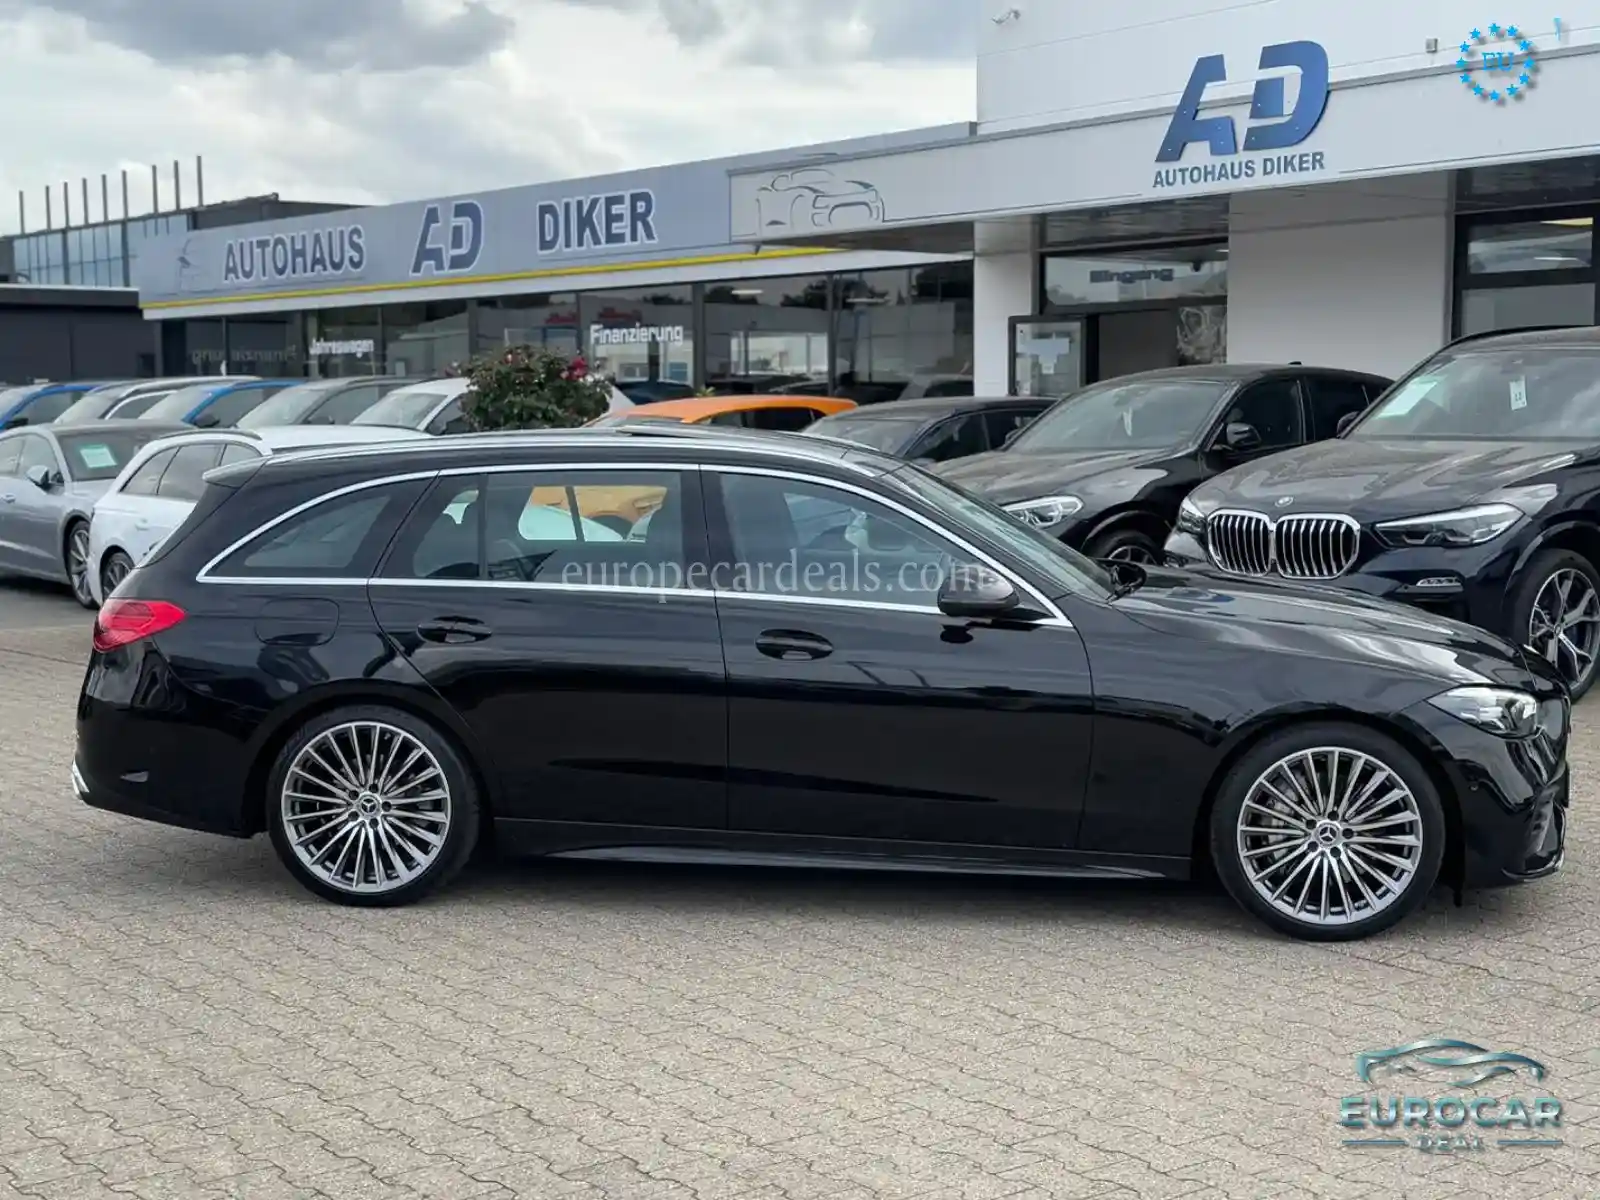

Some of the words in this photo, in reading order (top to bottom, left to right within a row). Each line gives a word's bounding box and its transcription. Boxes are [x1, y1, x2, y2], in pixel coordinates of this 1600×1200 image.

[1155, 40, 1329, 162] AD
[1153, 159, 1255, 189] AUTOHAUS
[1262, 151, 1325, 176] DIKER
[224, 226, 364, 281] AUTOHAUS
[411, 201, 483, 275] AD
[538, 191, 657, 252] DIKER
[1090, 269, 1174, 284] Eingang
[590, 323, 684, 346] Finanzierung
